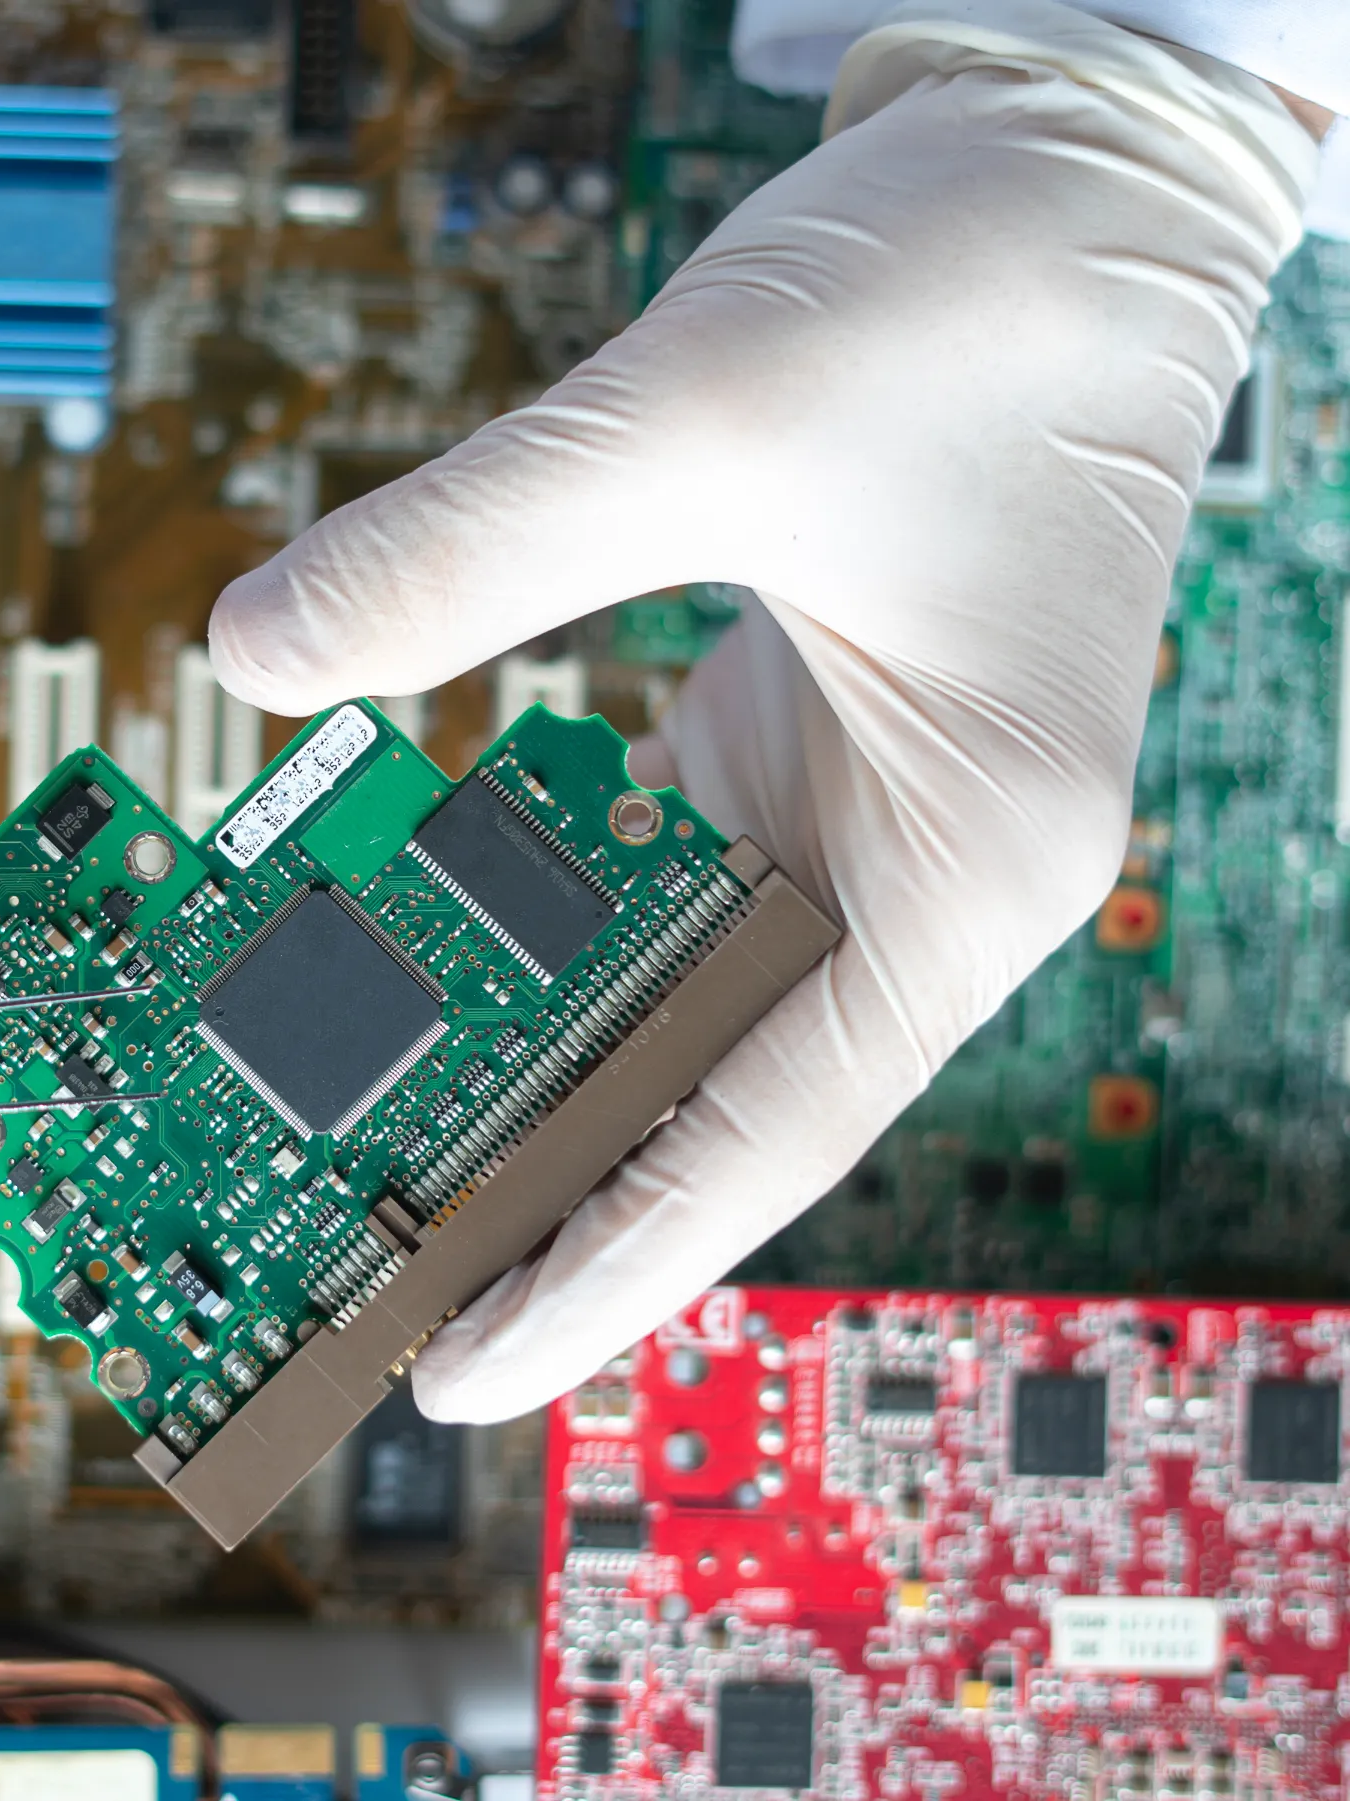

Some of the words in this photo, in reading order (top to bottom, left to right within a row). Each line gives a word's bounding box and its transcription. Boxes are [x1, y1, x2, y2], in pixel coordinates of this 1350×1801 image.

[124, 961, 141, 978] 000
[176, 1268, 196, 1290] 35V
[186, 1279, 204, 1299] 6.8
